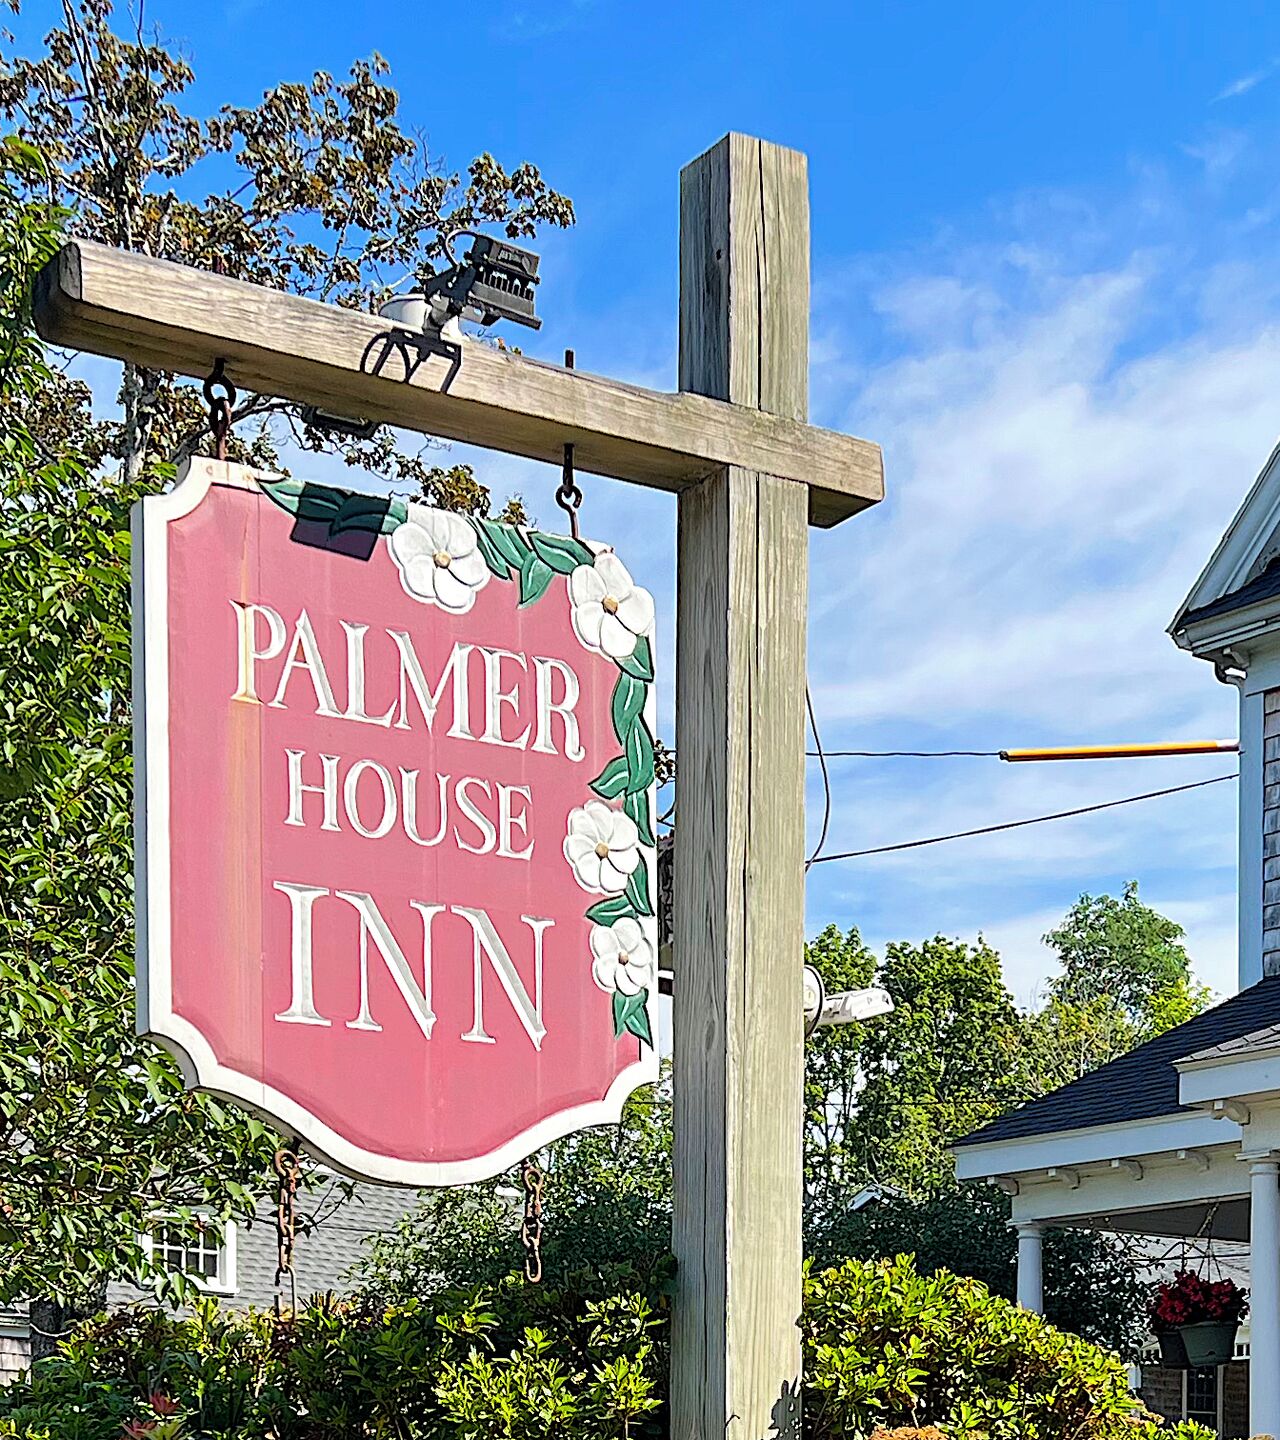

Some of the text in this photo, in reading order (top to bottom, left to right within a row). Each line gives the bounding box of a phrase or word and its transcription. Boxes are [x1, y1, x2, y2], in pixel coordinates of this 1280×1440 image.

[229, 599, 586, 763] PALMER
[283, 748, 536, 861] HOUSE
[273, 880, 556, 1053] INN
